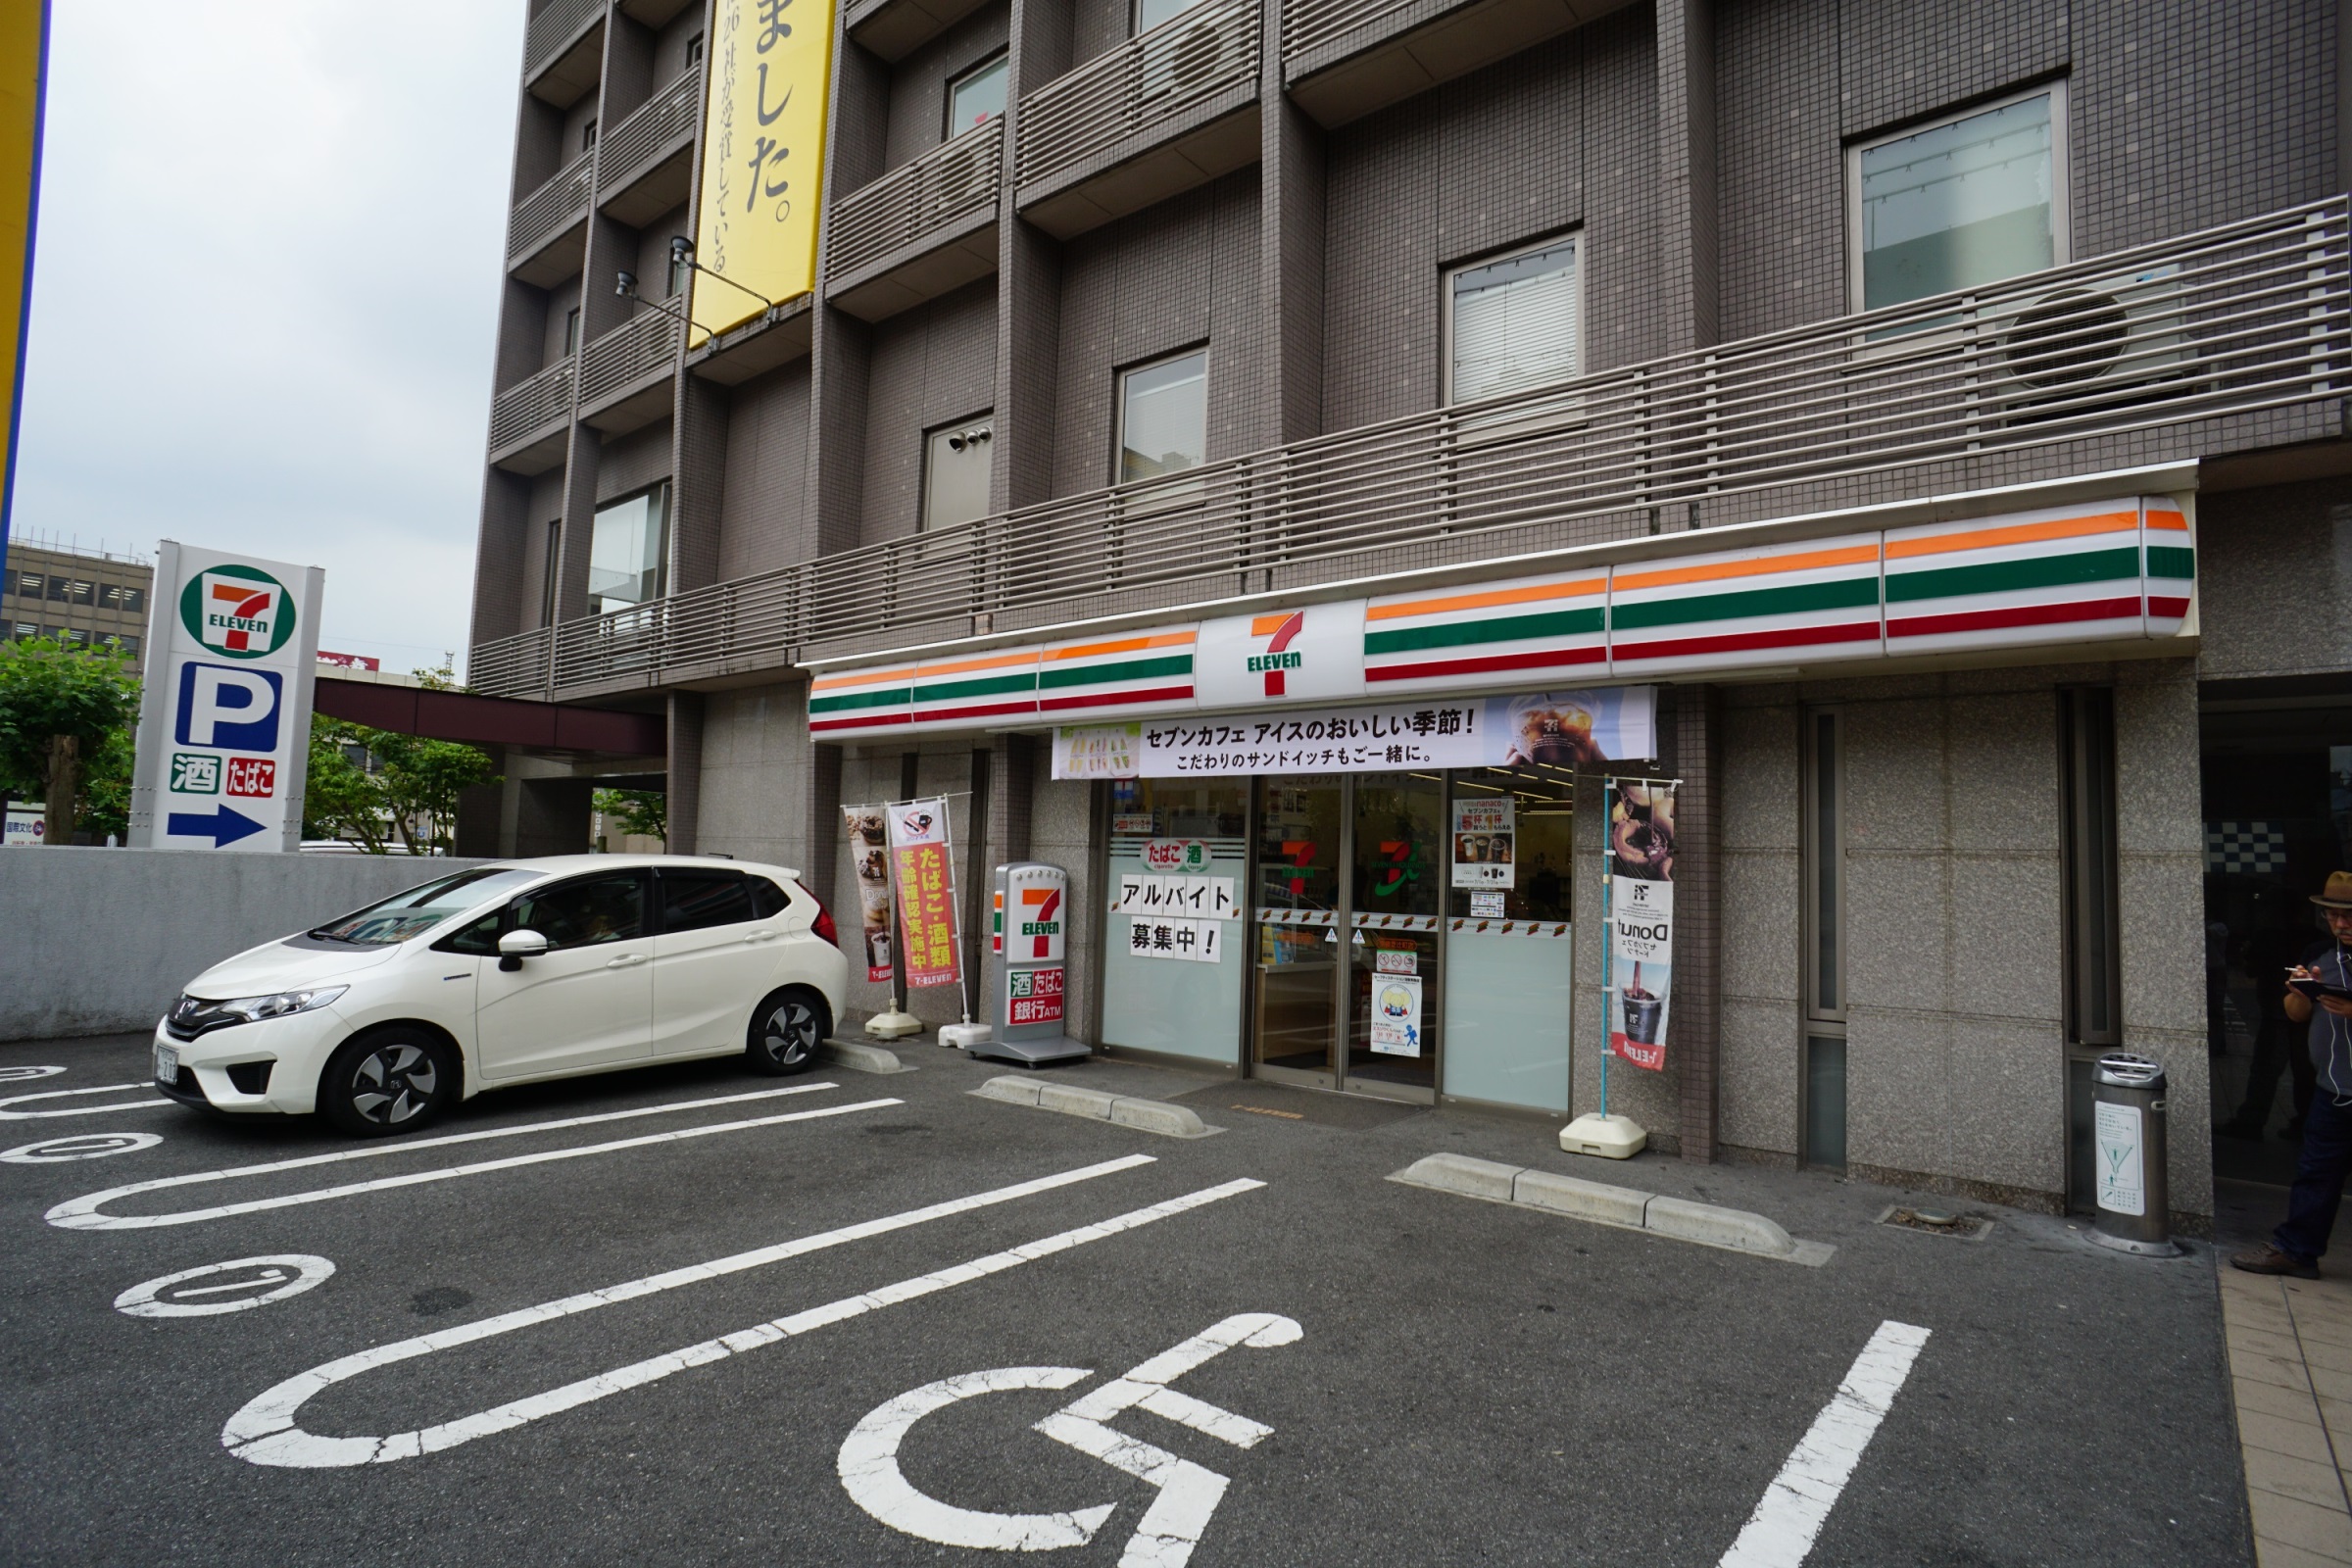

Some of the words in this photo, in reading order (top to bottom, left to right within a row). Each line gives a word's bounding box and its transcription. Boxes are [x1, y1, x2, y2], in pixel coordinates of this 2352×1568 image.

[747, 0, 795, 221] ました。
[213, 583, 270, 652] 7
[1251, 611, 1304, 697] 7
[189, 665, 274, 745] P
[1147, 726, 1246, 748] セブンカフェ
[1177, 745, 1431, 770] こだわりのサンドイッチもご一緒に。
[172, 754, 219, 792] 酒
[228, 760, 274, 794] たばこ
[1149, 844, 1181, 862] たばこ
[1187, 845, 1201, 863] 酒
[1282, 840, 1317, 895] 7
[900, 850, 927, 970] 年齢確認実施中
[919, 848, 952, 968] たばこ・酒類
[1022, 888, 1060, 957] 7
[1123, 883, 1229, 910] アルバイト
[1132, 923, 1215, 955] 募集中!
[1012, 973, 1032, 997] 酒
[1034, 971, 1062, 995] たばこ
